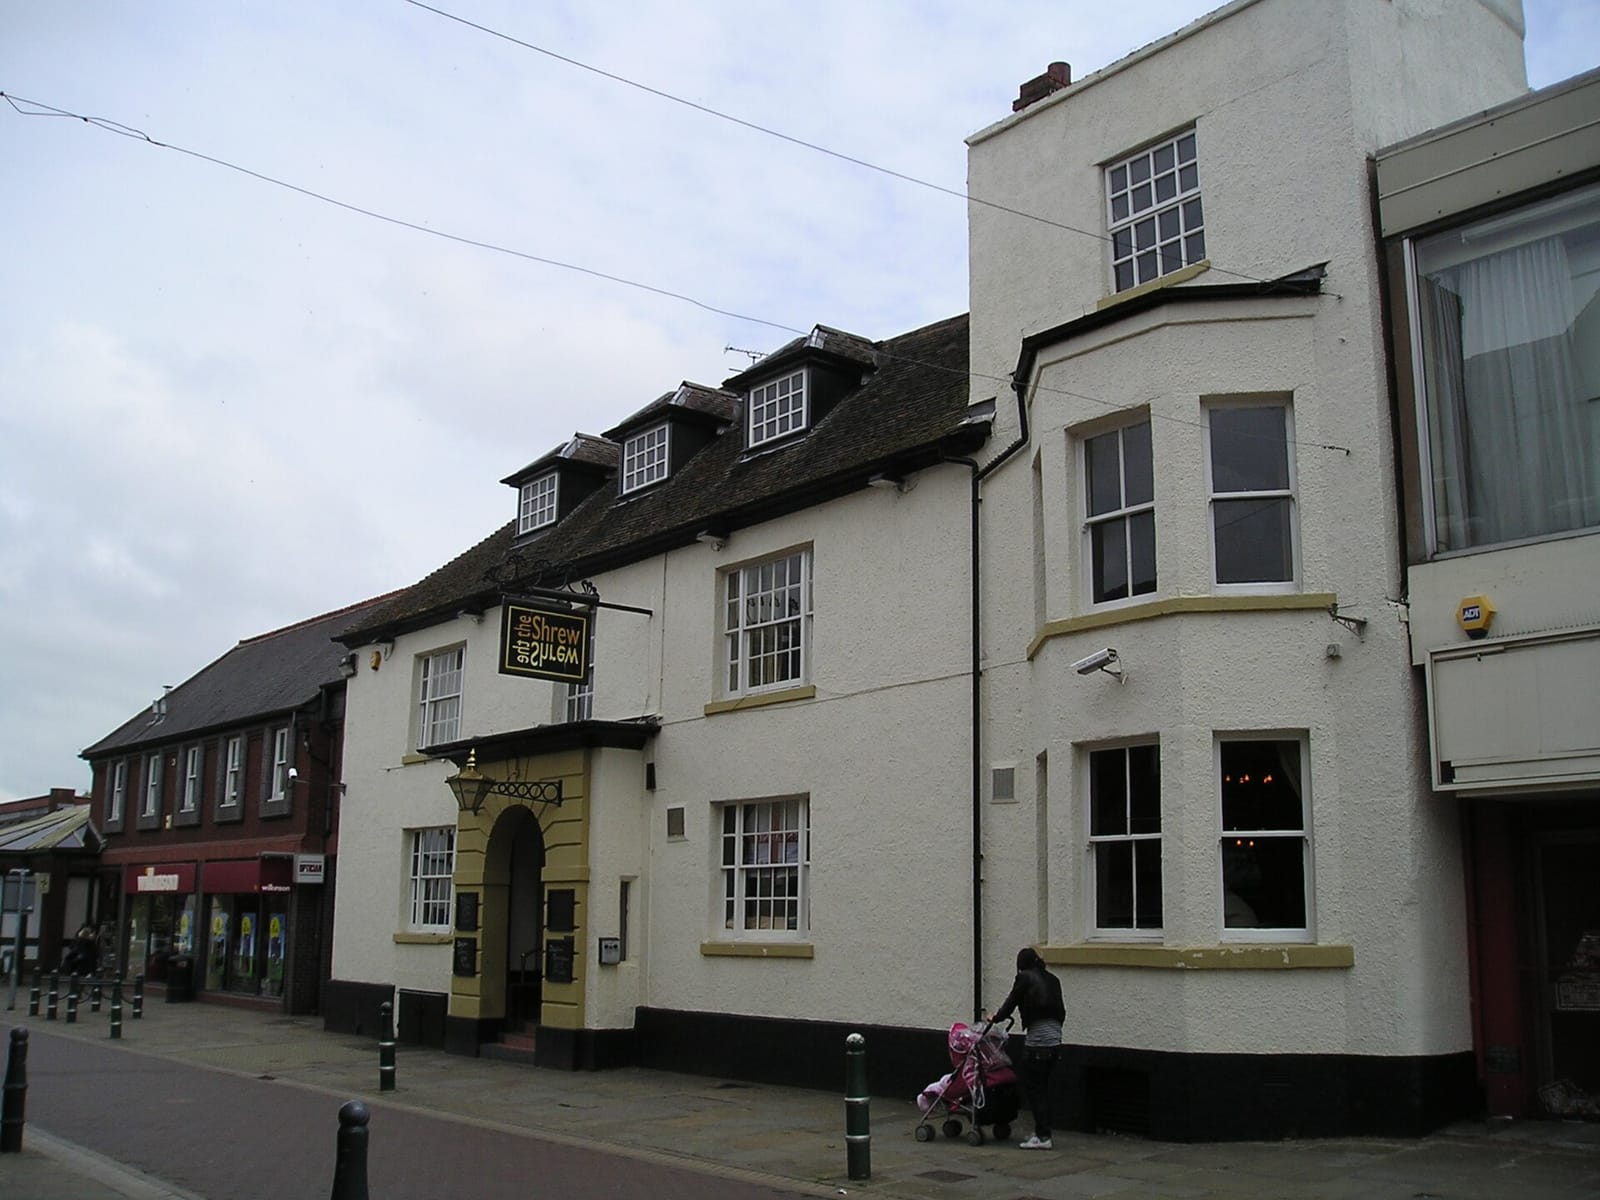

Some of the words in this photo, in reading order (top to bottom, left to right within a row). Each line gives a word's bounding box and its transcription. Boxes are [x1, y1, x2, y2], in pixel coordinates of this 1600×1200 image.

[1463, 608, 1479, 618] ADT
[513, 616, 531, 637] the
[532, 615, 580, 645] Shrew
